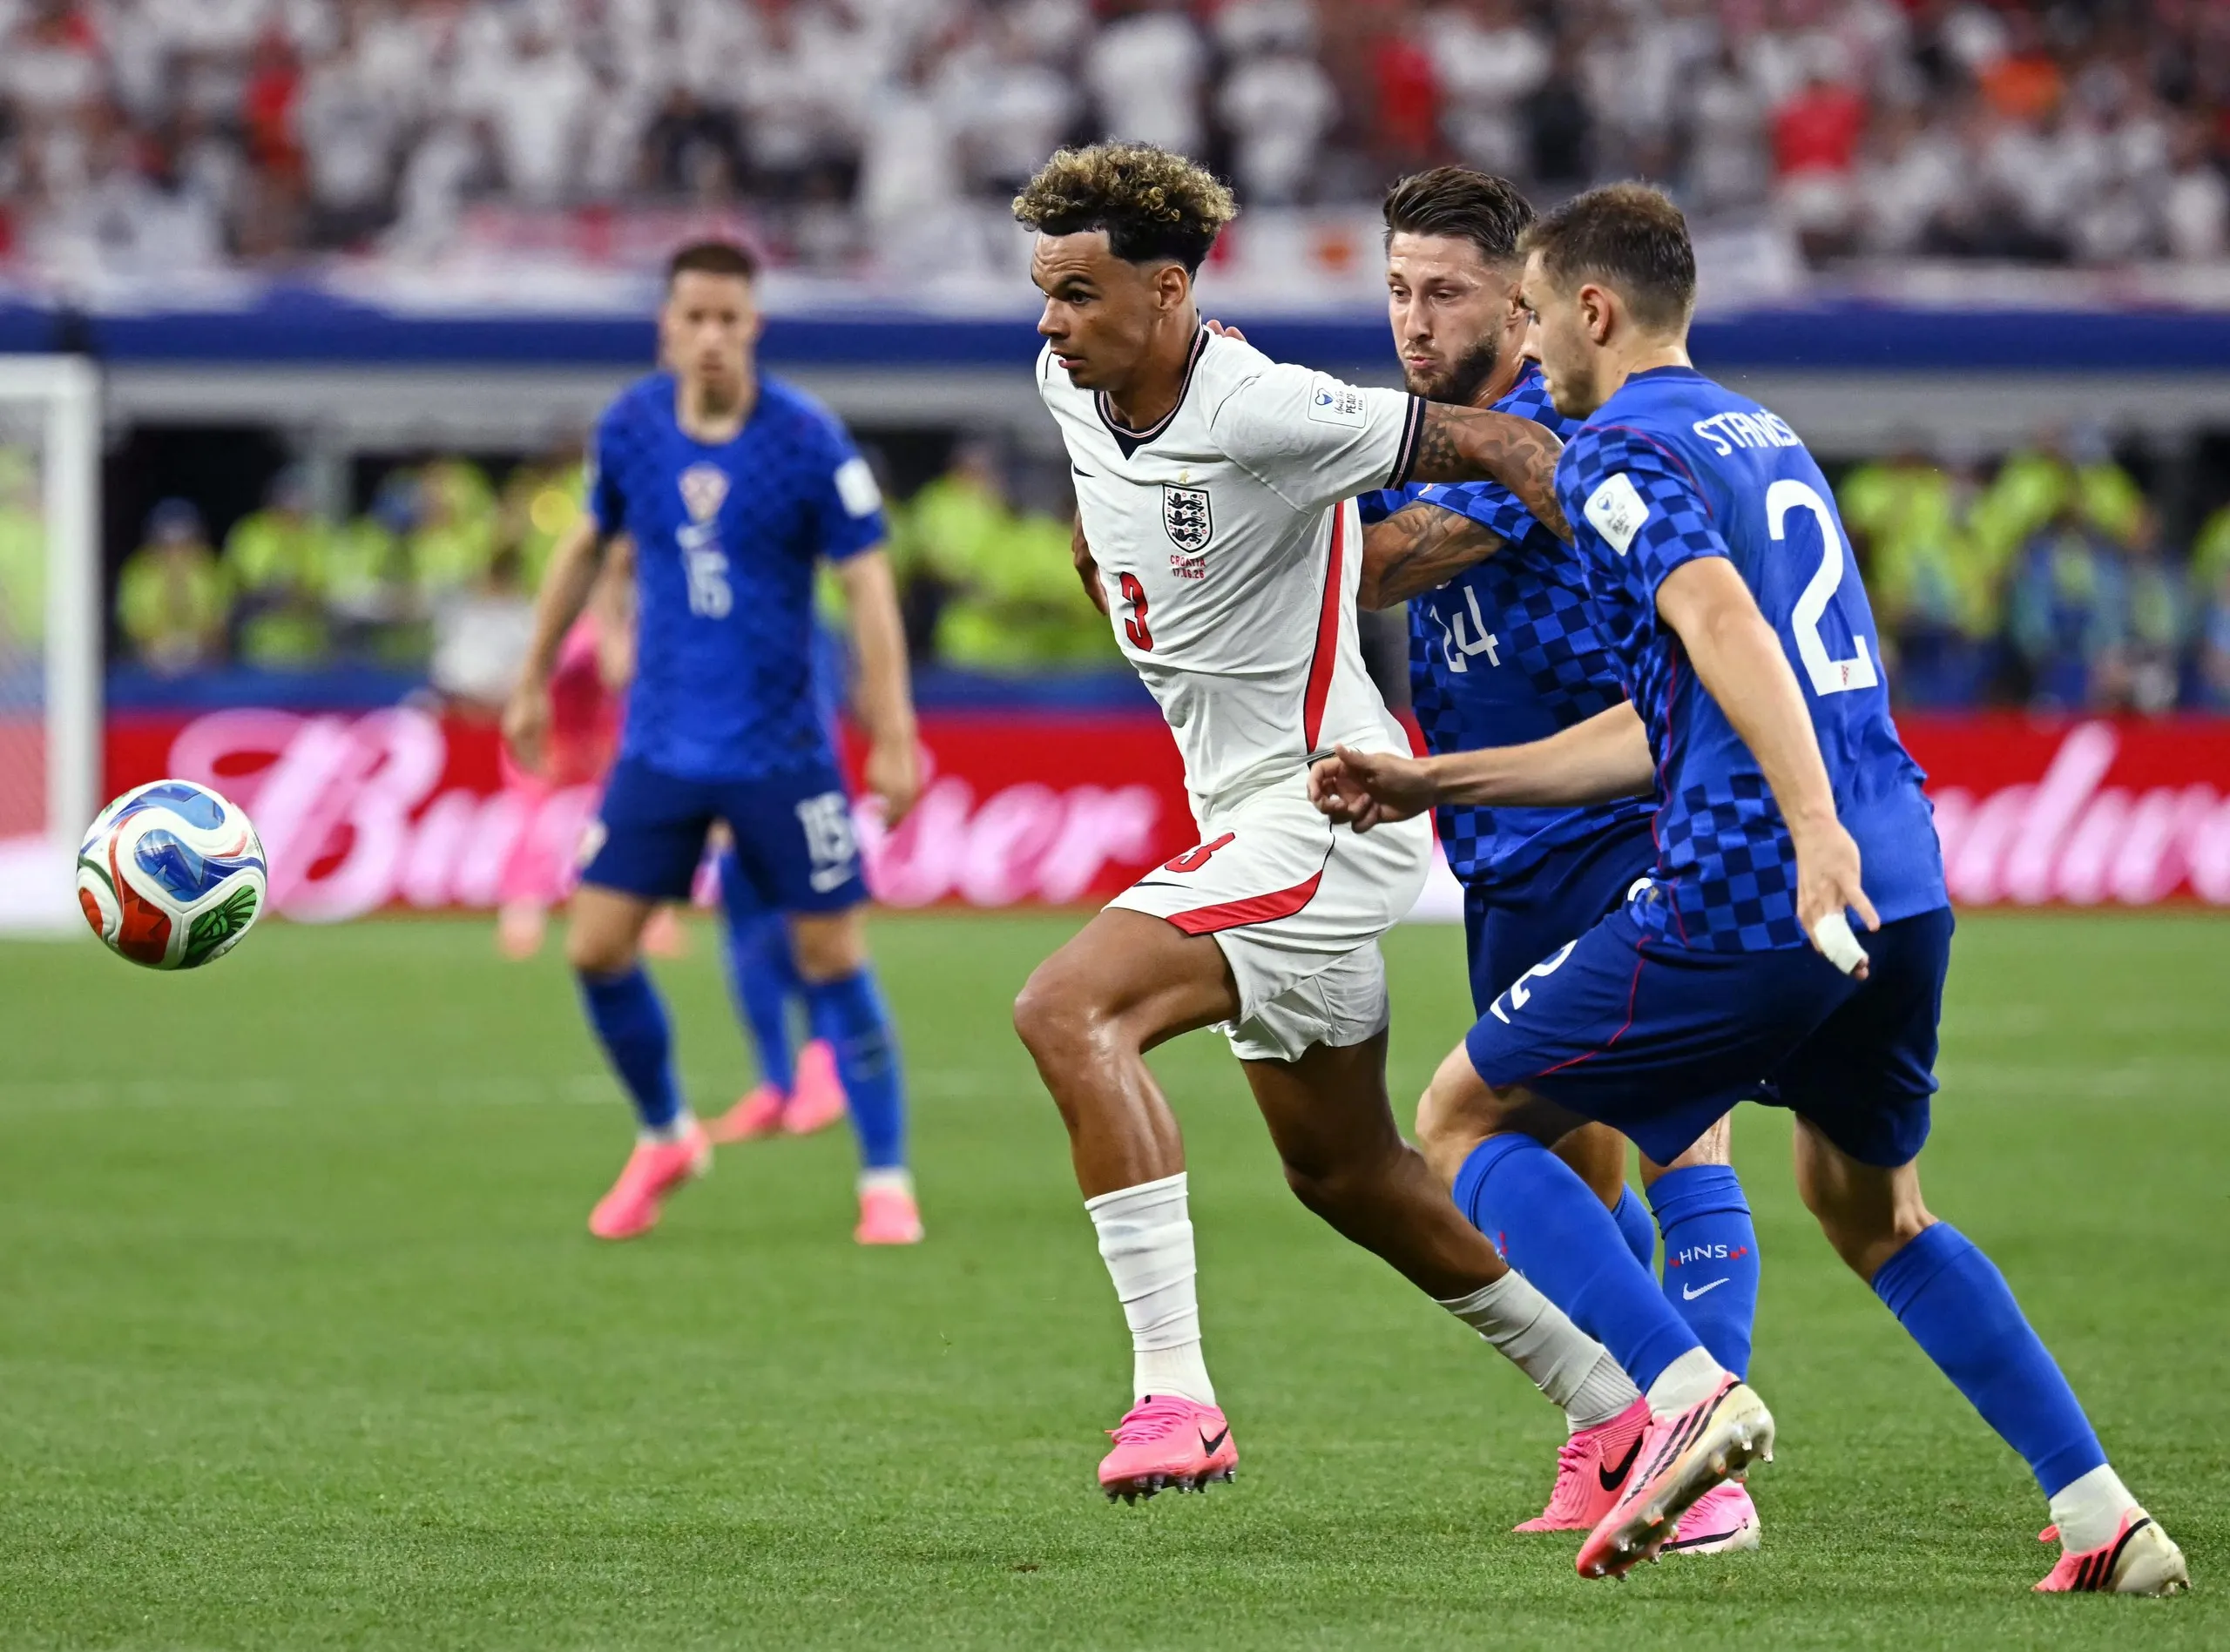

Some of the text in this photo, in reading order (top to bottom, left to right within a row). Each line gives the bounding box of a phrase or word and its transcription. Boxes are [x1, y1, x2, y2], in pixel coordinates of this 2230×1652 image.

[1170, 555, 1206, 567] CROATIA
[1766, 479, 1879, 697] 2
[1119, 571, 1153, 652] 3
[1429, 584, 1501, 673] 24
[796, 790, 854, 864] 15
[1679, 1244, 1728, 1265] HNS
